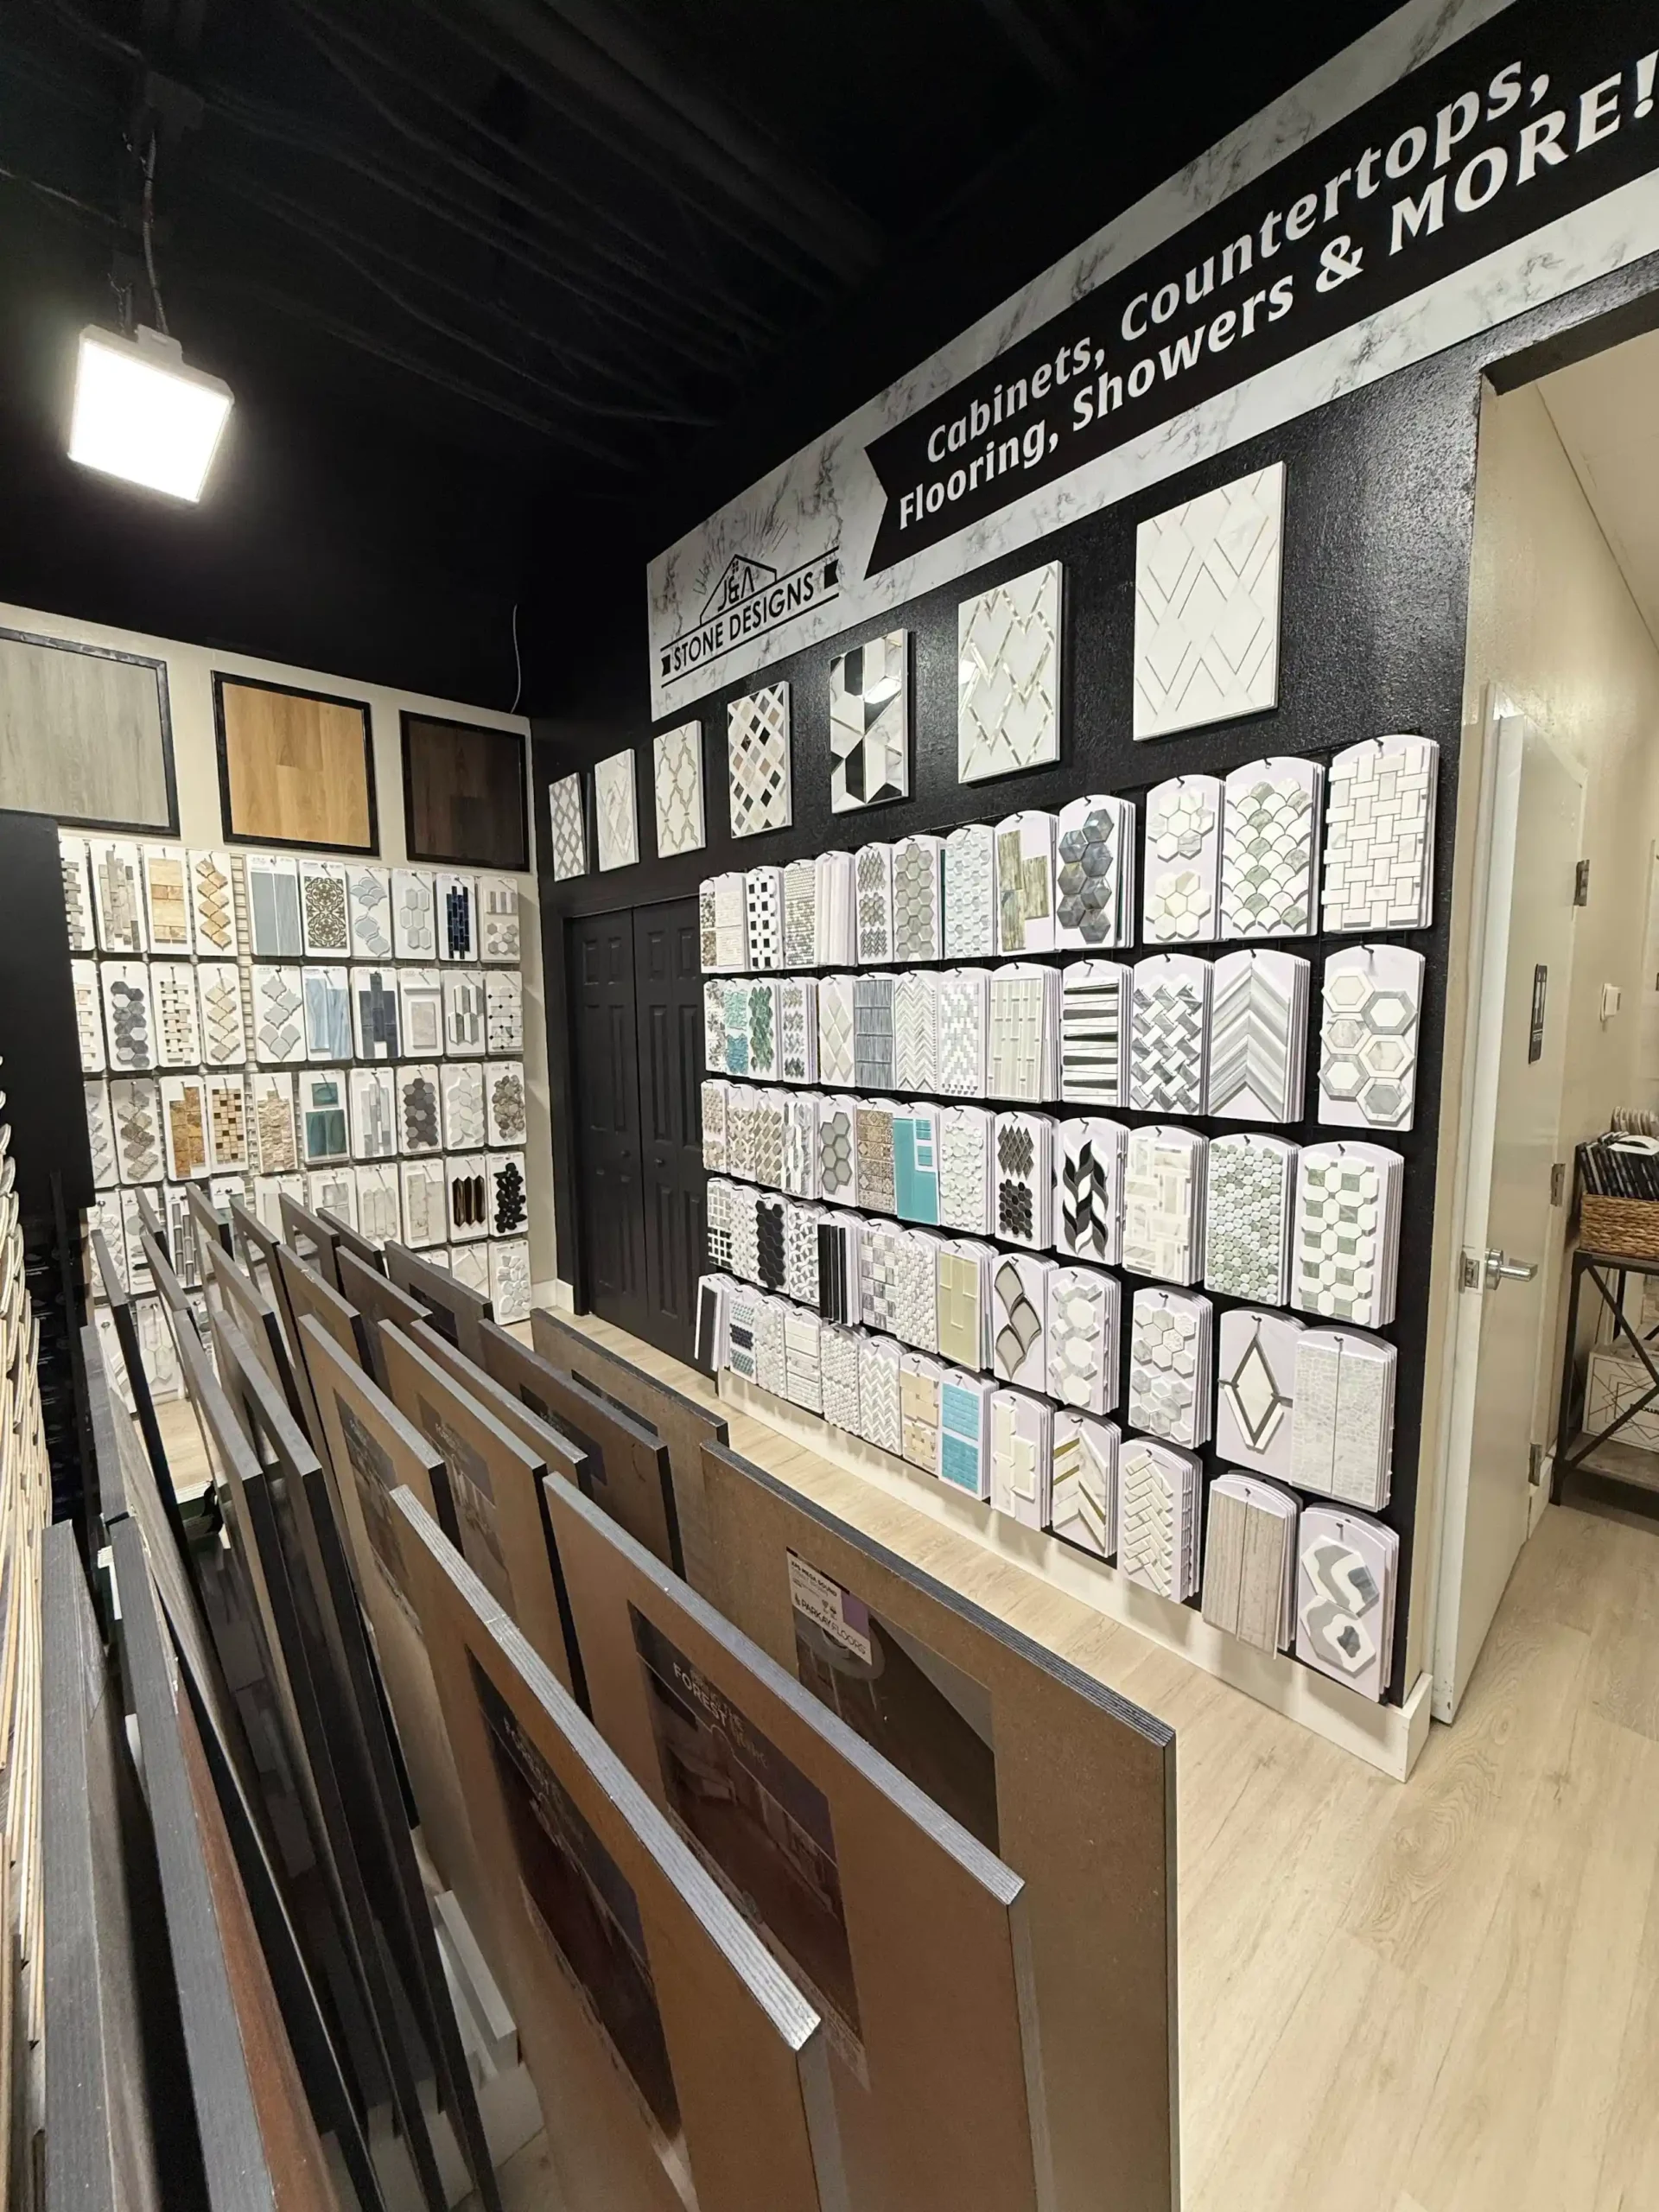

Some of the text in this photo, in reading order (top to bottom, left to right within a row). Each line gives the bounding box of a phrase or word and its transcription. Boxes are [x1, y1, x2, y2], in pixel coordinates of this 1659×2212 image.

[899, 49, 1659, 531] Flooring, Showers & MORE!
[927, 61, 1550, 463] Cabinets, Countertops,
[673, 571, 814, 671] STONE DESIGNS
[831, 1621, 866, 1655] FLOORS
